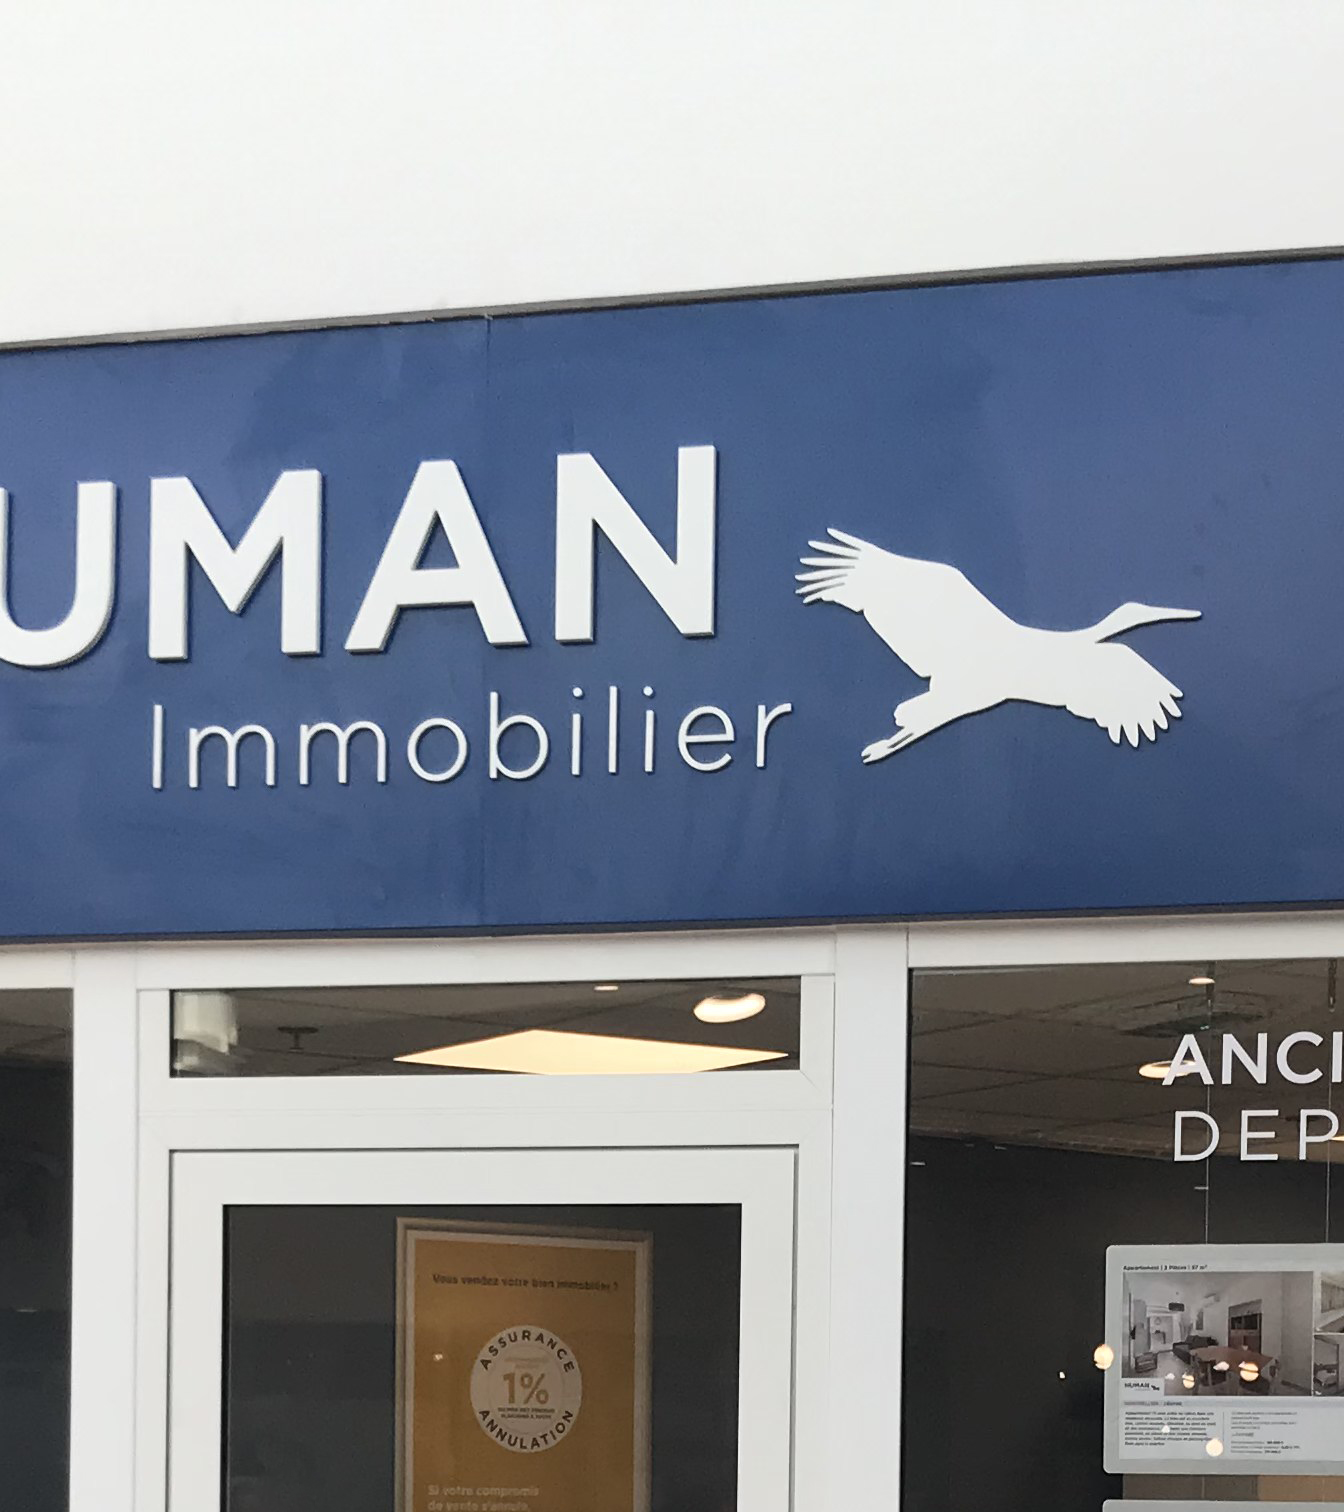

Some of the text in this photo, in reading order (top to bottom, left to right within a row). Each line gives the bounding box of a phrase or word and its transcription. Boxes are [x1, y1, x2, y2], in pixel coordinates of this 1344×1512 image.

[151, 685, 793, 789] Immobilier
[433, 1274, 457, 1284] Vous
[461, 1275, 498, 1286] vendez
[480, 1330, 575, 1372] ASSURANCE
[503, 1372, 549, 1405] 1%
[479, 1410, 573, 1450] ANNULATION
[442, 1486, 473, 1496] votre
[476, 1486, 539, 1498] compromis
